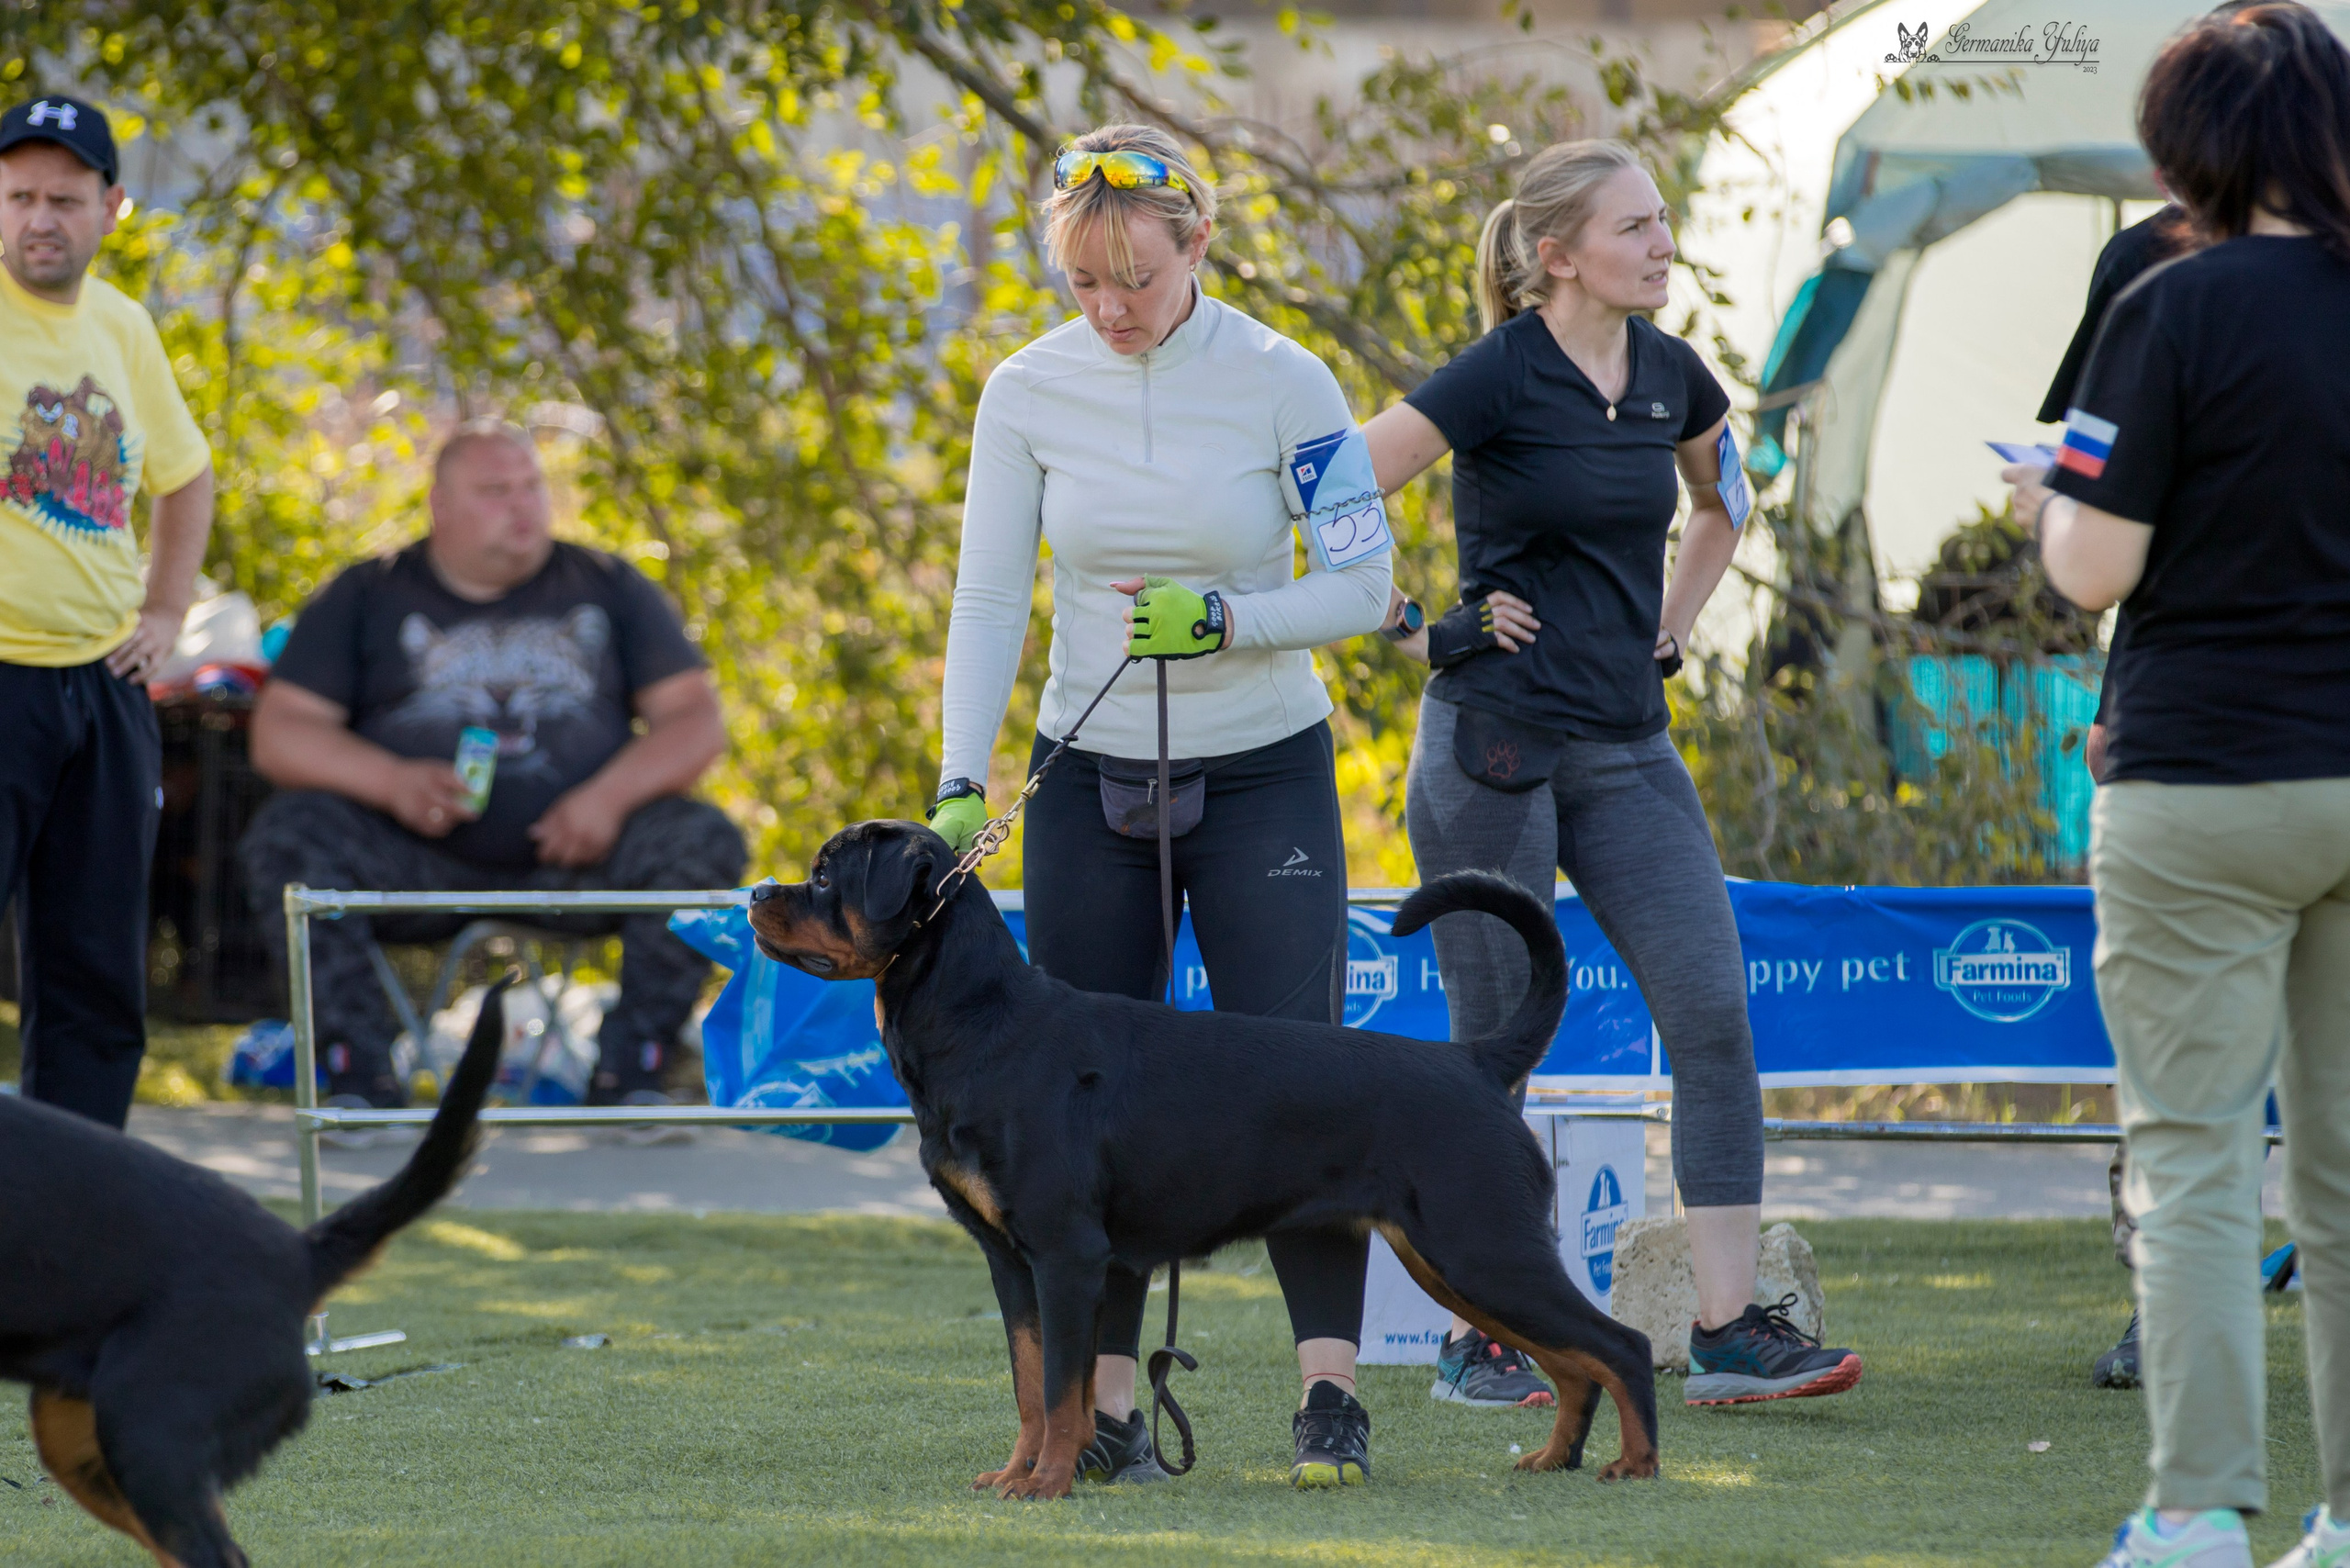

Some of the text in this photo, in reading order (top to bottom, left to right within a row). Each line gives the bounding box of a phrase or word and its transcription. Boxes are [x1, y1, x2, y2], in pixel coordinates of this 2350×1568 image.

[1267, 868, 1323, 877] DEMIX
[1749, 958, 1824, 995] ppy
[1841, 949, 1911, 992] pet
[1946, 955, 2057, 981] Farmina
[1974, 989, 2032, 1003] Pet Foods
